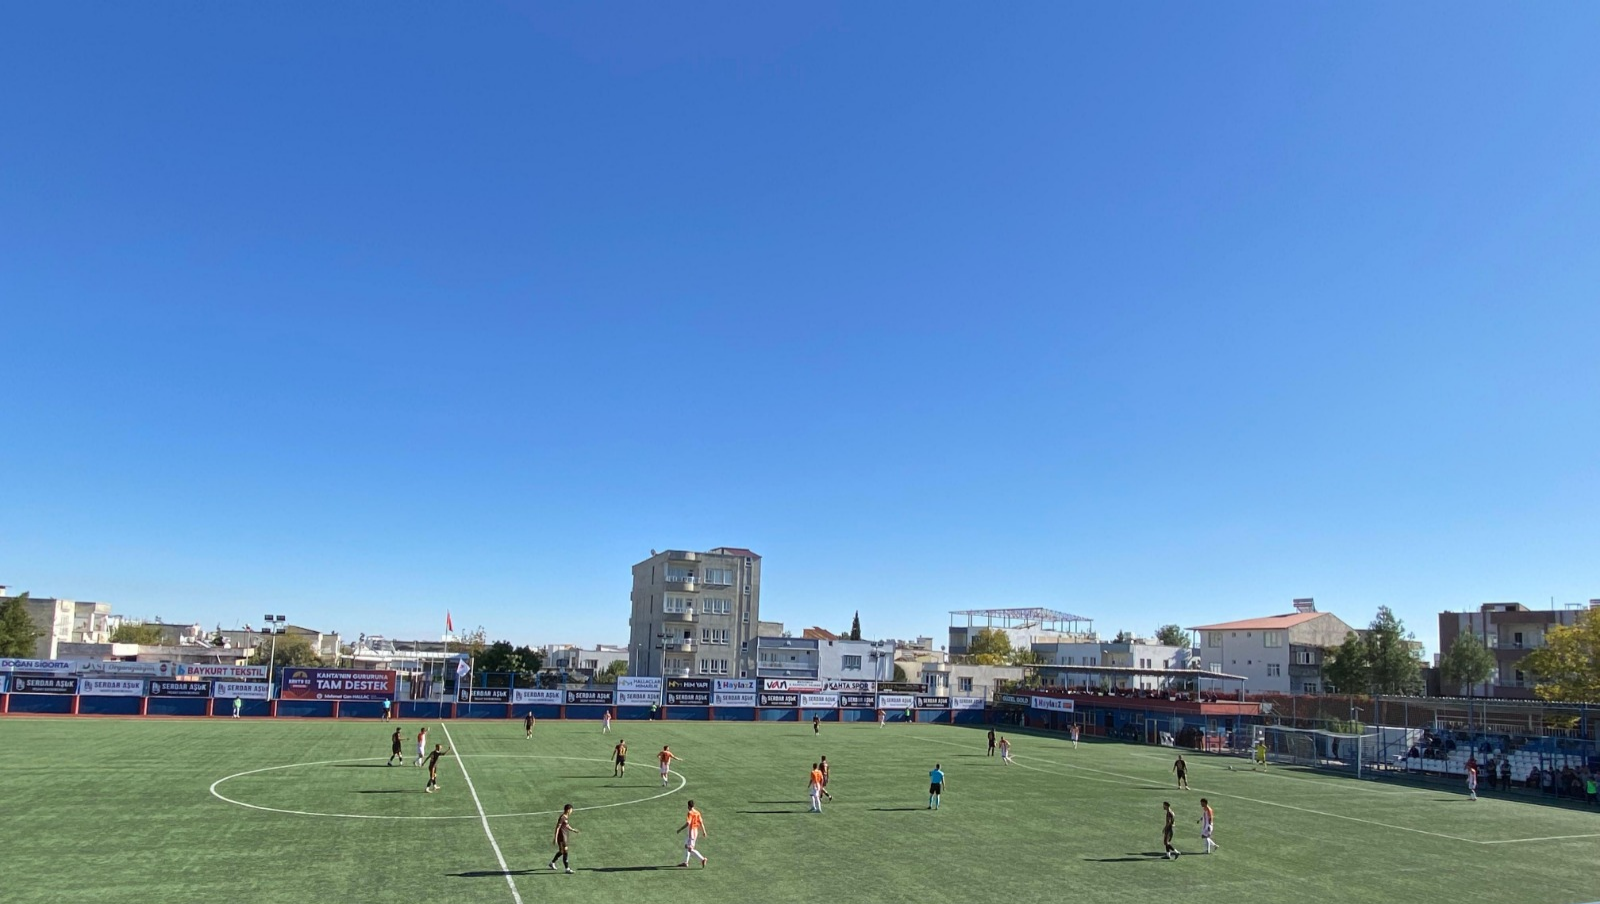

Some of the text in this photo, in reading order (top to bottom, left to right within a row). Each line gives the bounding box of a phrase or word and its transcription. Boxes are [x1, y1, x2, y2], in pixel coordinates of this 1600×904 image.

[188, 666, 228, 675] BAYKURT
[316, 680, 388, 690] TAM DESTEK
